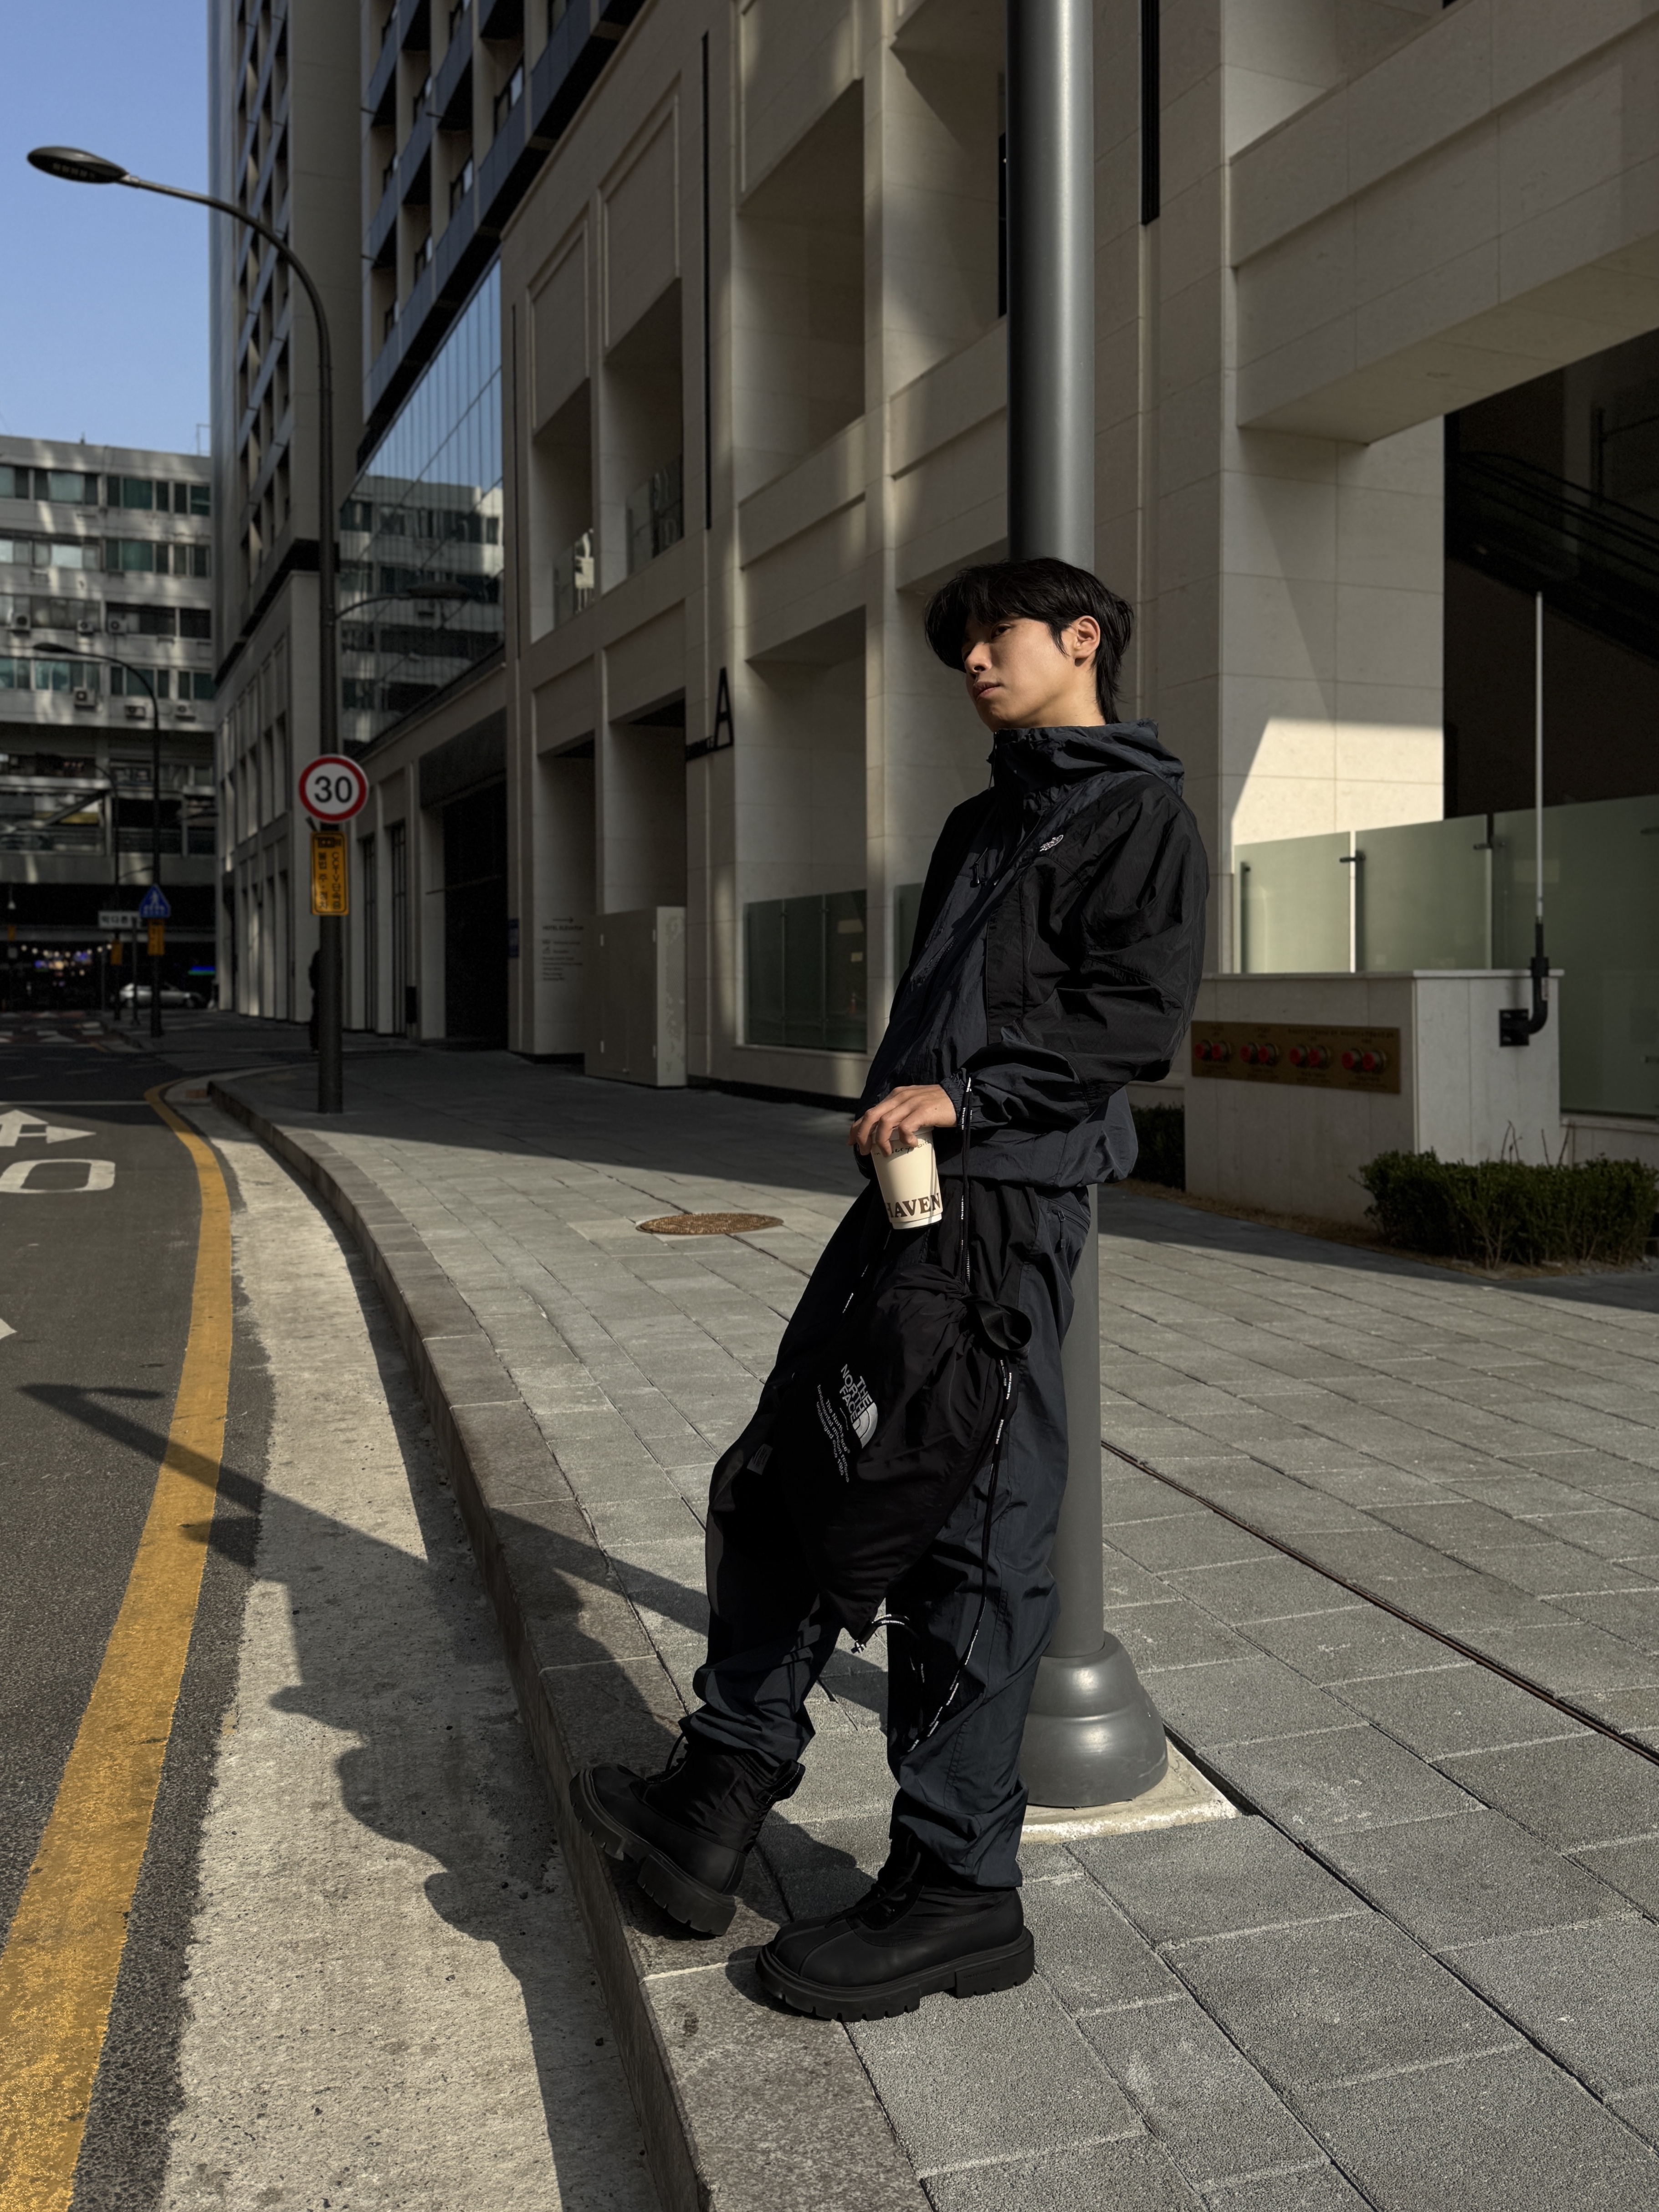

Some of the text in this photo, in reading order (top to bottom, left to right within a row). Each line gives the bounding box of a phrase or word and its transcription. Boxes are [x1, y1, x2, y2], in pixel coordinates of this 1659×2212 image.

[714, 666, 734, 748] A
[314, 775, 352, 803] 30
[817, 1384, 834, 1427] fundamental
[840, 1364, 865, 1416] NORTH
[840, 1385, 858, 1423] FACE
[857, 1375, 873, 1408] THE
[817, 1401, 834, 1439] unchanged
[832, 1413, 843, 1433] North
